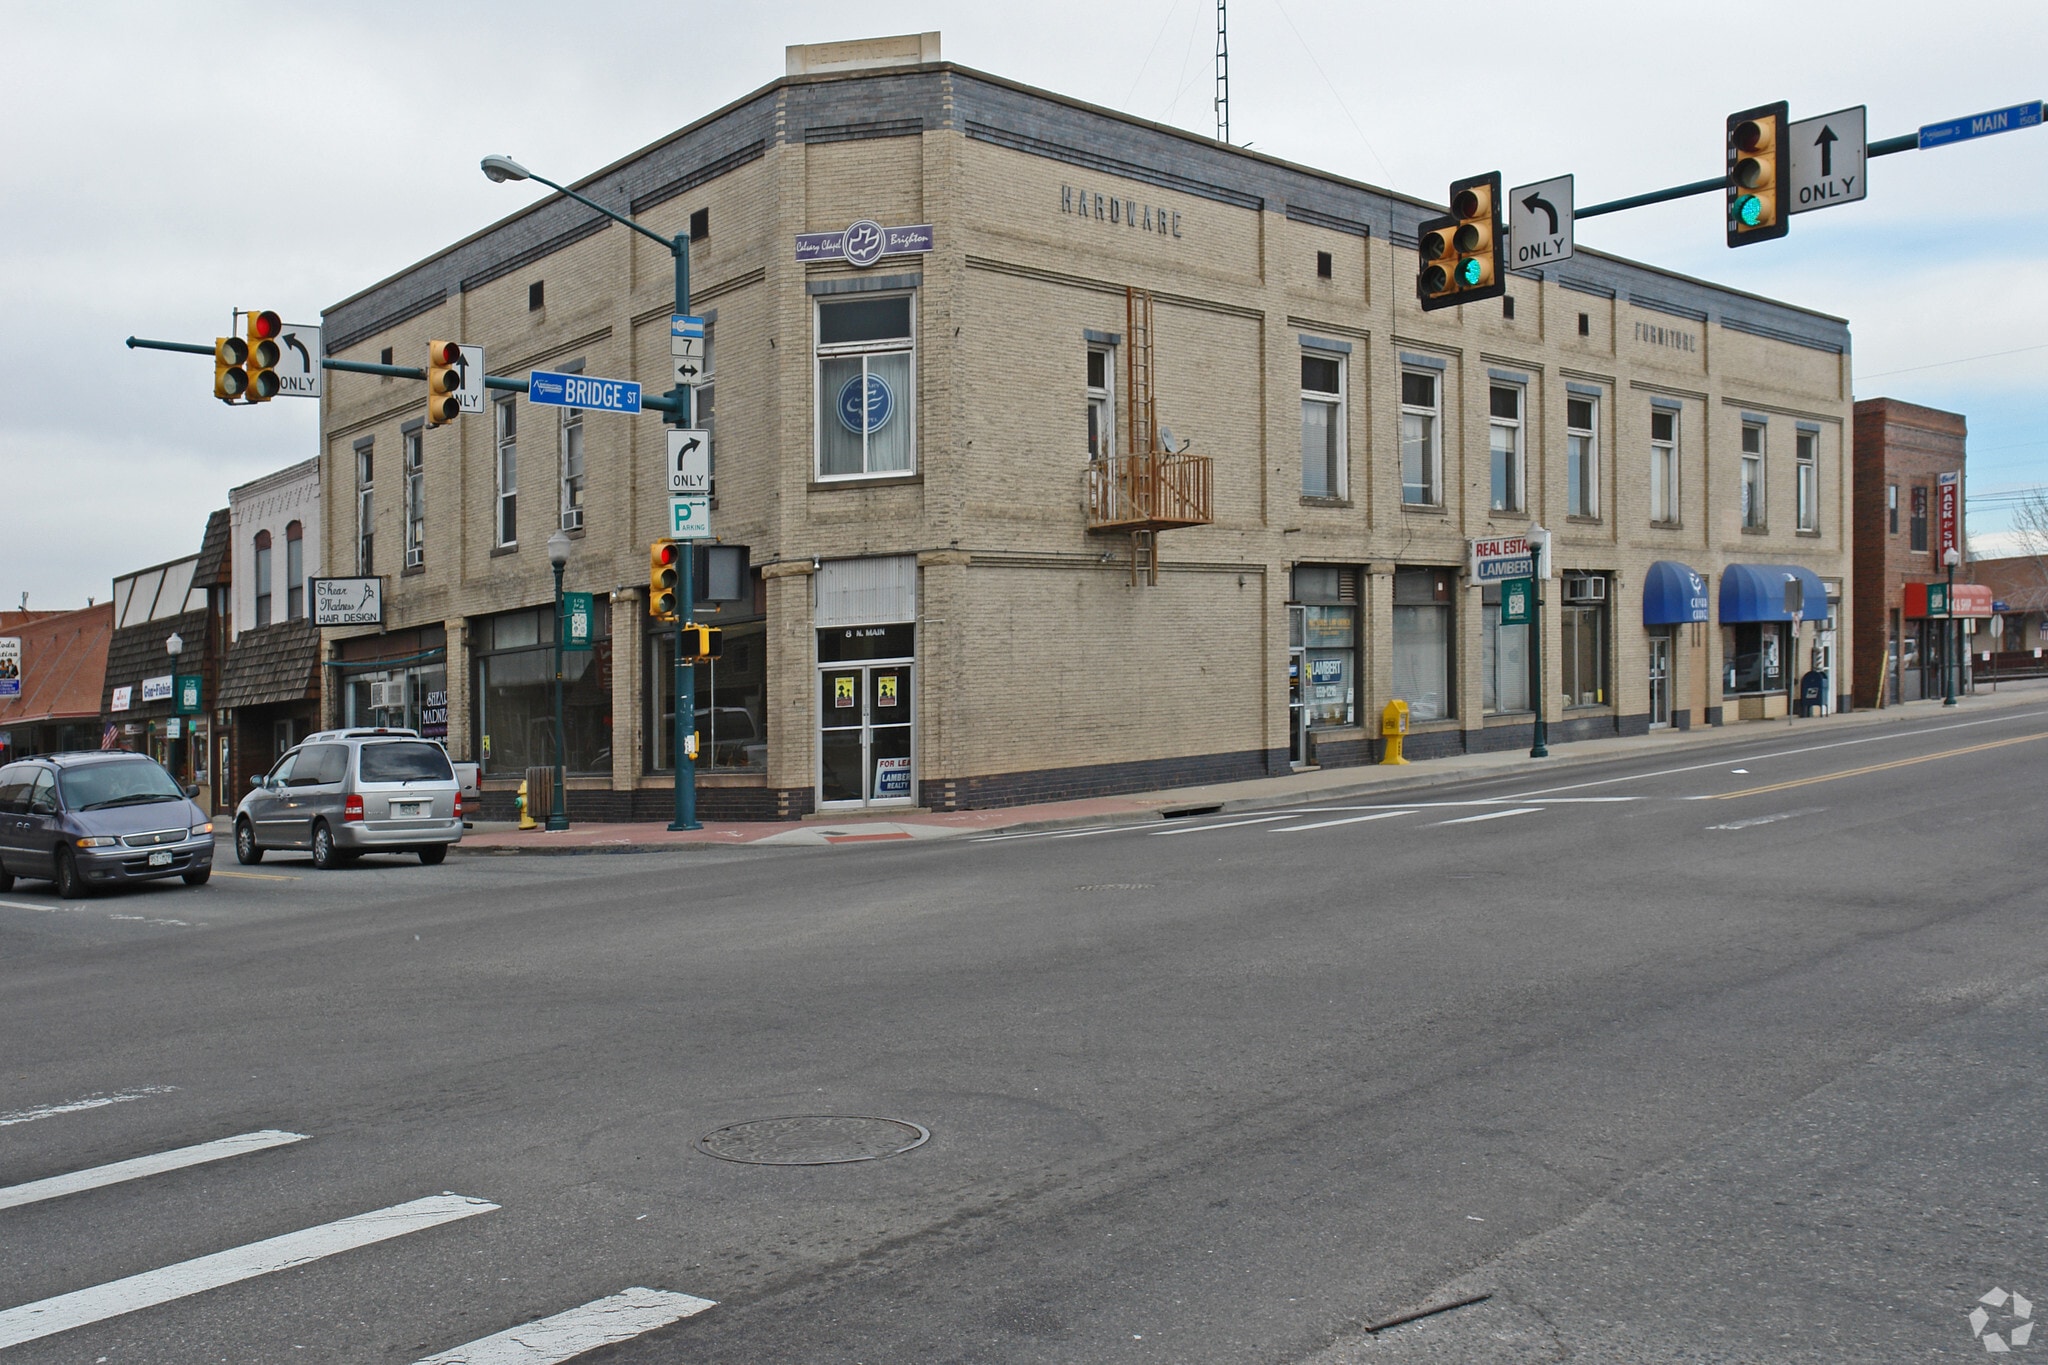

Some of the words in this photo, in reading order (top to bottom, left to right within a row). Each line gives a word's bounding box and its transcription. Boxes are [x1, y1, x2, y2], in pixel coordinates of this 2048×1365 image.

[1972, 112, 2008, 134] MAIN
[2020, 106, 2029, 115] ST
[1800, 176, 1855, 204] ONLY
[1062, 185, 1182, 237] HARDWARE
[890, 232, 929, 247] Brighton
[1518, 237, 1565, 262] ONLY
[1635, 321, 1696, 353] FURNITURE
[682, 338, 693, 355] 7
[280, 376, 315, 391] ONLY
[452, 394, 478, 407] NLY
[565, 379, 623, 408] BRIDGE
[627, 391, 637, 404] ST
[673, 475, 704, 487] ONLY
[1943, 486, 1953, 518] PACK
[1943, 531, 1953, 548] SH
[1476, 541, 1501, 557] REAL
[1503, 538, 1531, 555] ESTA
[1480, 559, 1533, 577] LAMBERT
[317, 581, 347, 596] Shear
[320, 597, 355, 611] Madness
[319, 614, 339, 623] HAIR
[344, 612, 377, 622] DESIGN
[845, 629, 852, 638] 8
[856, 629, 864, 637] N.
[866, 628, 885, 636] MAIN
[1312, 660, 1341, 675] LAMBERT
[422, 708, 448, 724] MADNE
[879, 760, 895, 768] FOR
[898, 759, 911, 767] LEA
[881, 772, 911, 782] LAMBER
[886, 782, 909, 790] REALTY
